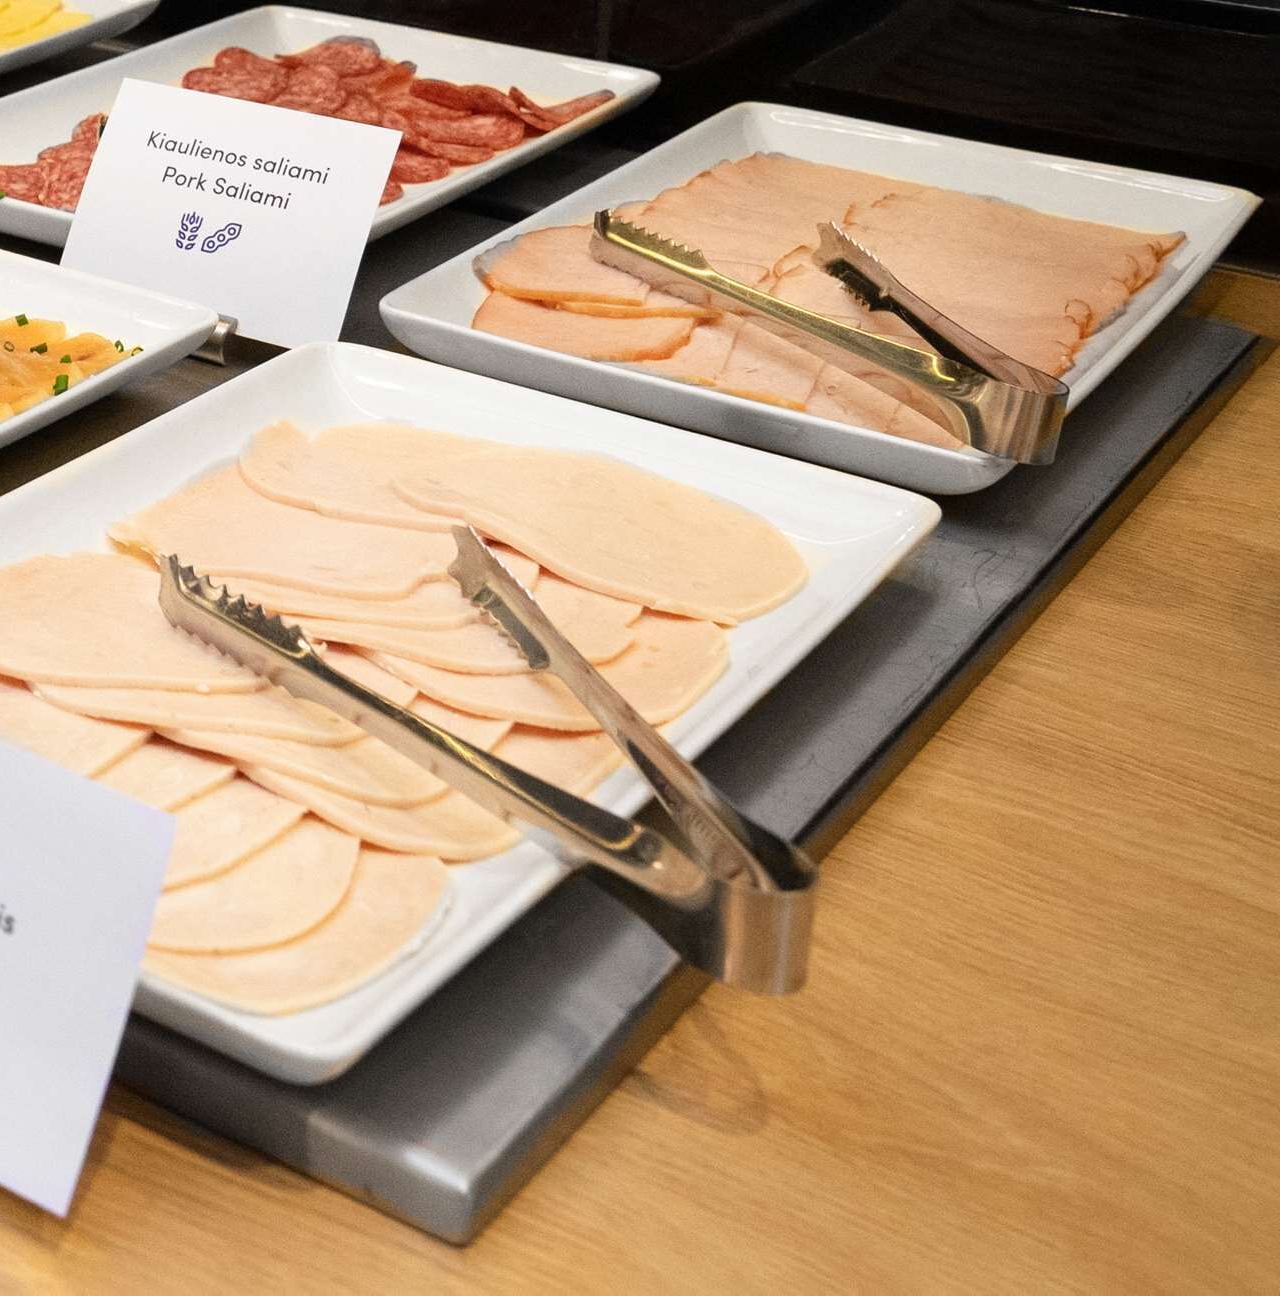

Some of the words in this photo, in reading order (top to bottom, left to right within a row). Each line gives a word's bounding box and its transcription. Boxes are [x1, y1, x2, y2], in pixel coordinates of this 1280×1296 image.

[146, 130, 247, 167] Kiaulienos
[252, 157, 330, 185] saliami
[162, 166, 206, 192] Pork
[212, 177, 291, 210] Saliami
